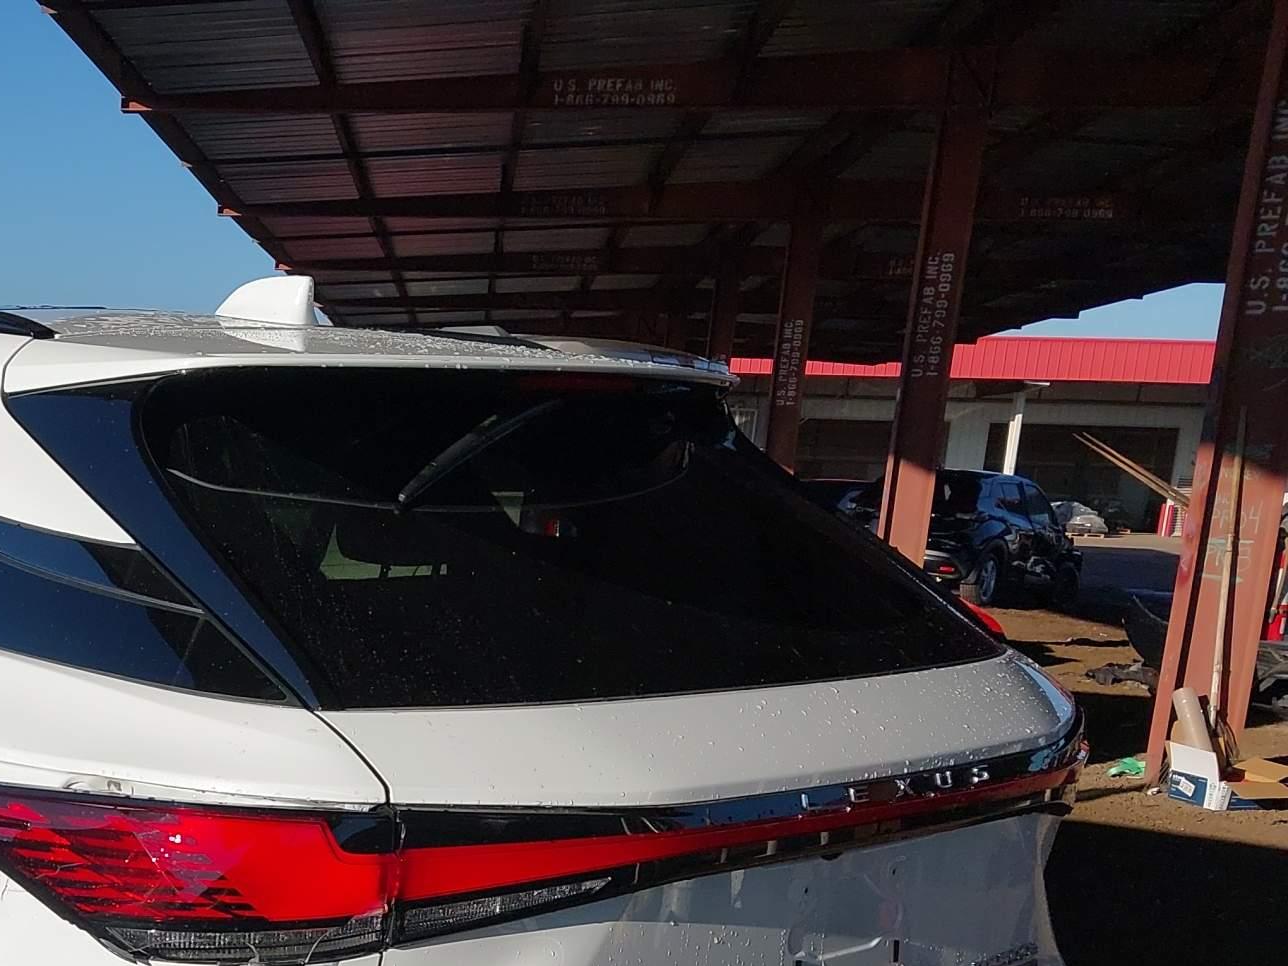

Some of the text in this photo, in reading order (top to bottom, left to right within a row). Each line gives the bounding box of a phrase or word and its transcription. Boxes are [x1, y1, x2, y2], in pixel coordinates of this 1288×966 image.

[588, 78, 644, 93] PREFAB
[1255, 154, 1288, 254] PREFAB
[923, 249, 942, 280] INC.
[915, 285, 936, 343] PREFAB
[1245, 267, 1274, 316] U.S.
[800, 763, 991, 811] LEXUS
